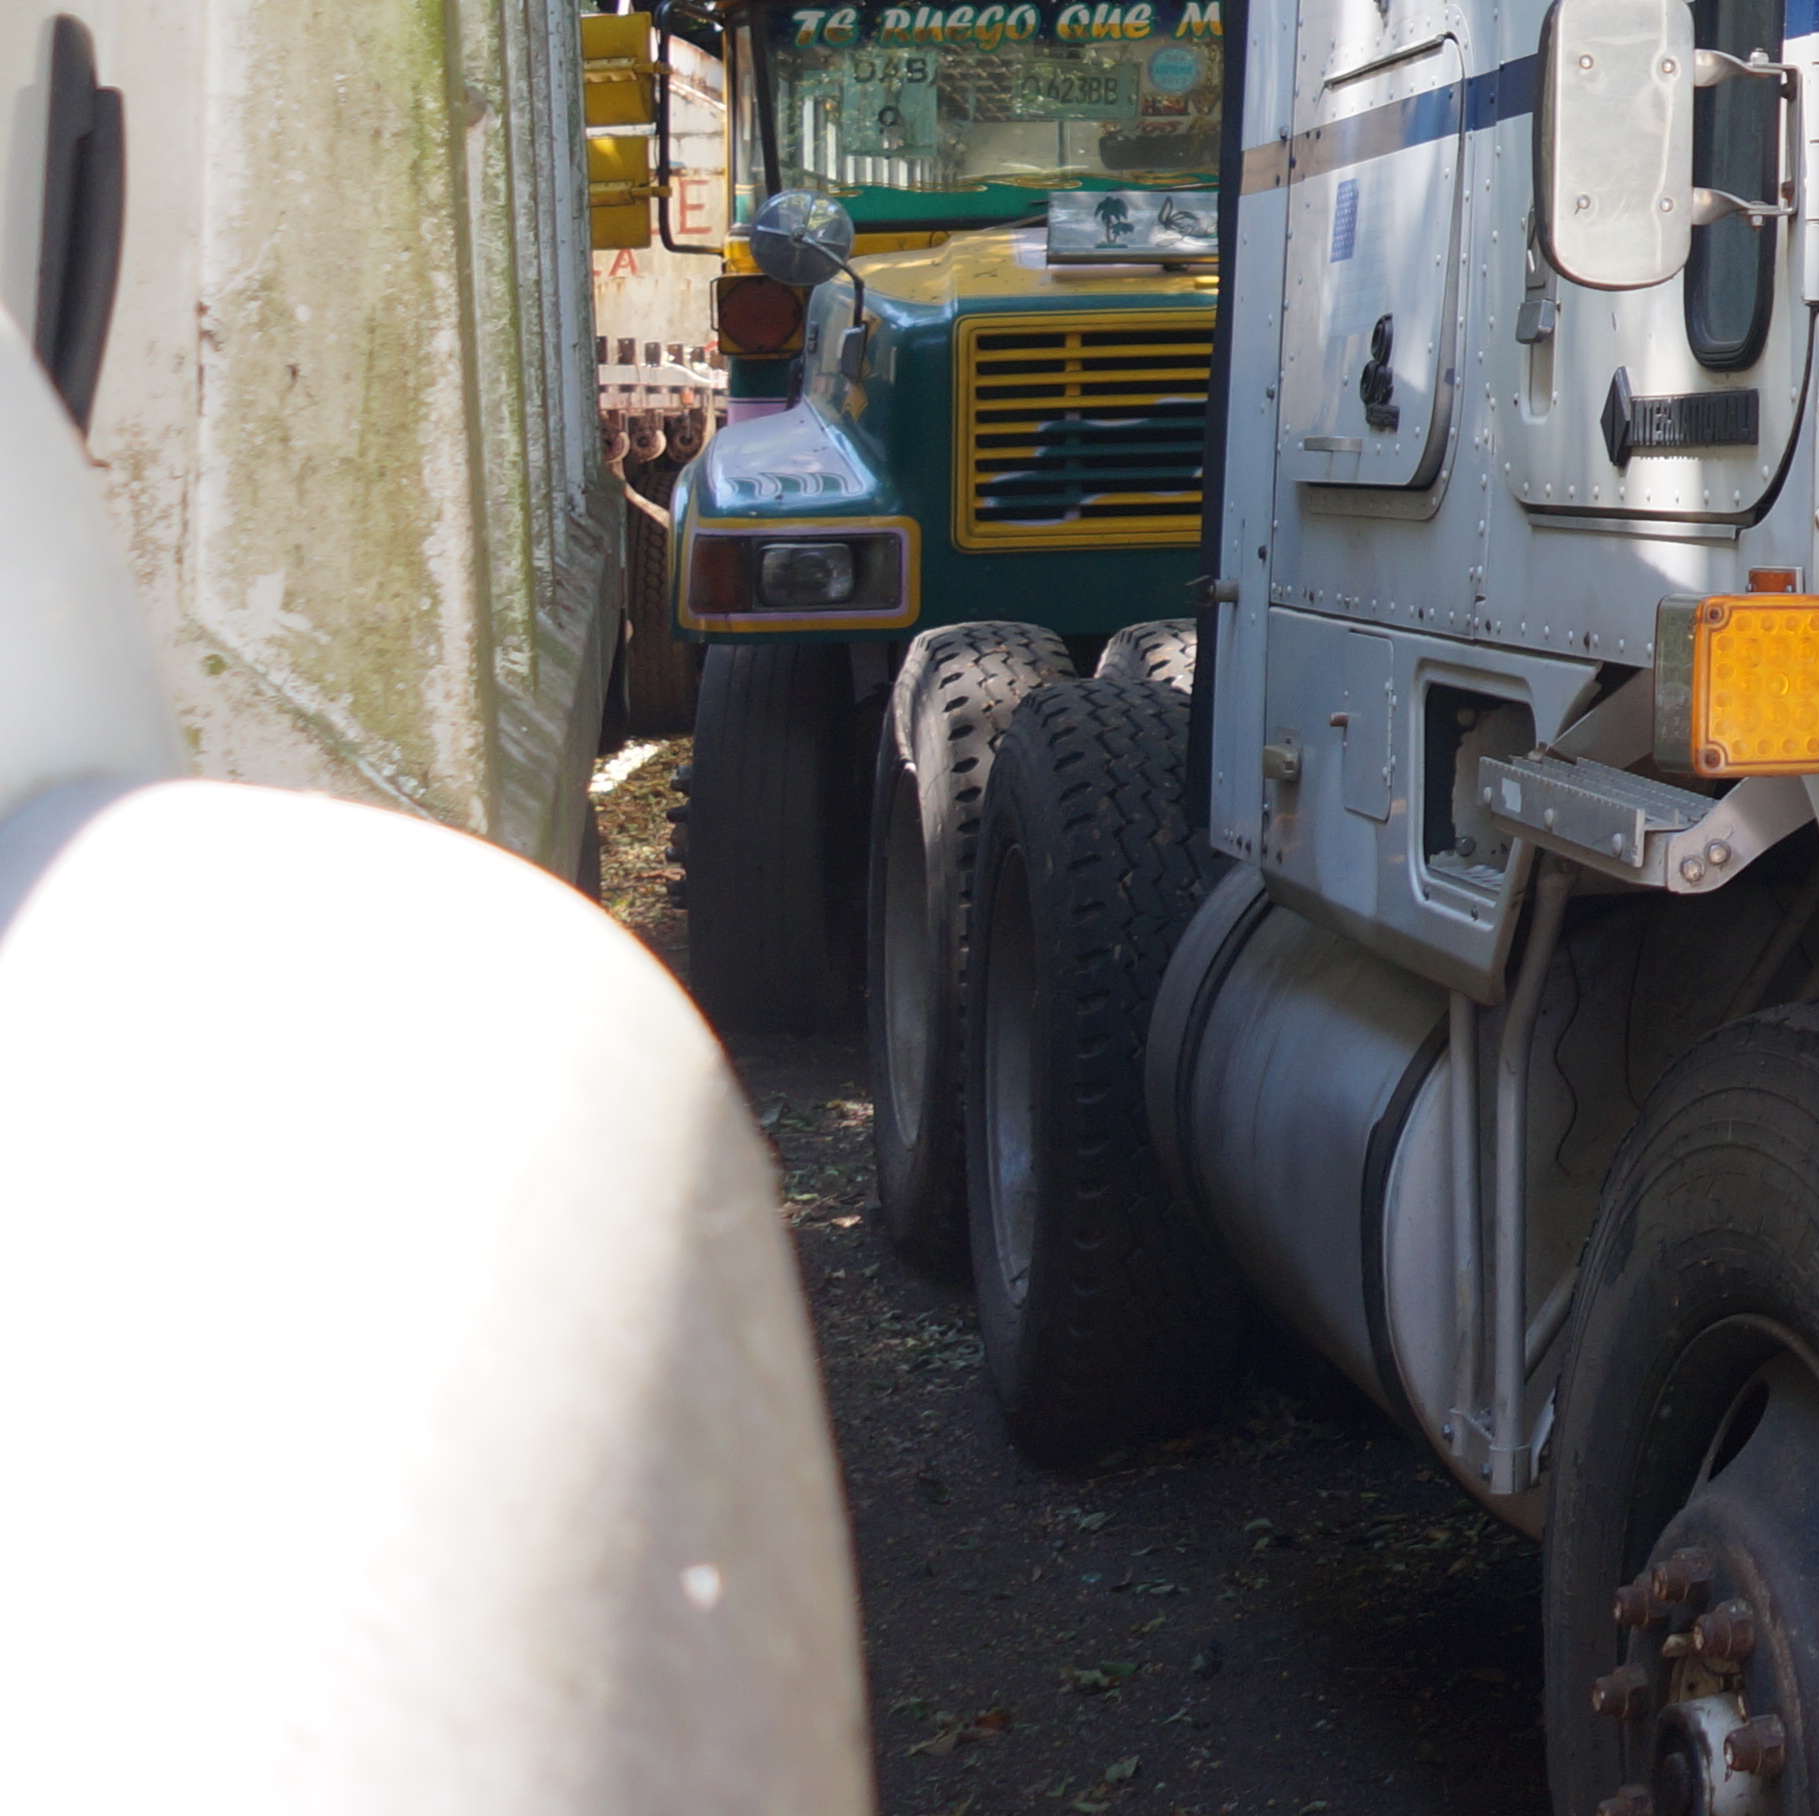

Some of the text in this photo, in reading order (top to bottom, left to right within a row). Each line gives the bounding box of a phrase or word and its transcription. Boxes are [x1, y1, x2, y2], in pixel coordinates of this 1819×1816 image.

[792, 7, 858, 47] TE
[880, 3, 1040, 52] RUEGO
[1056, 1, 1154, 42] QUE
